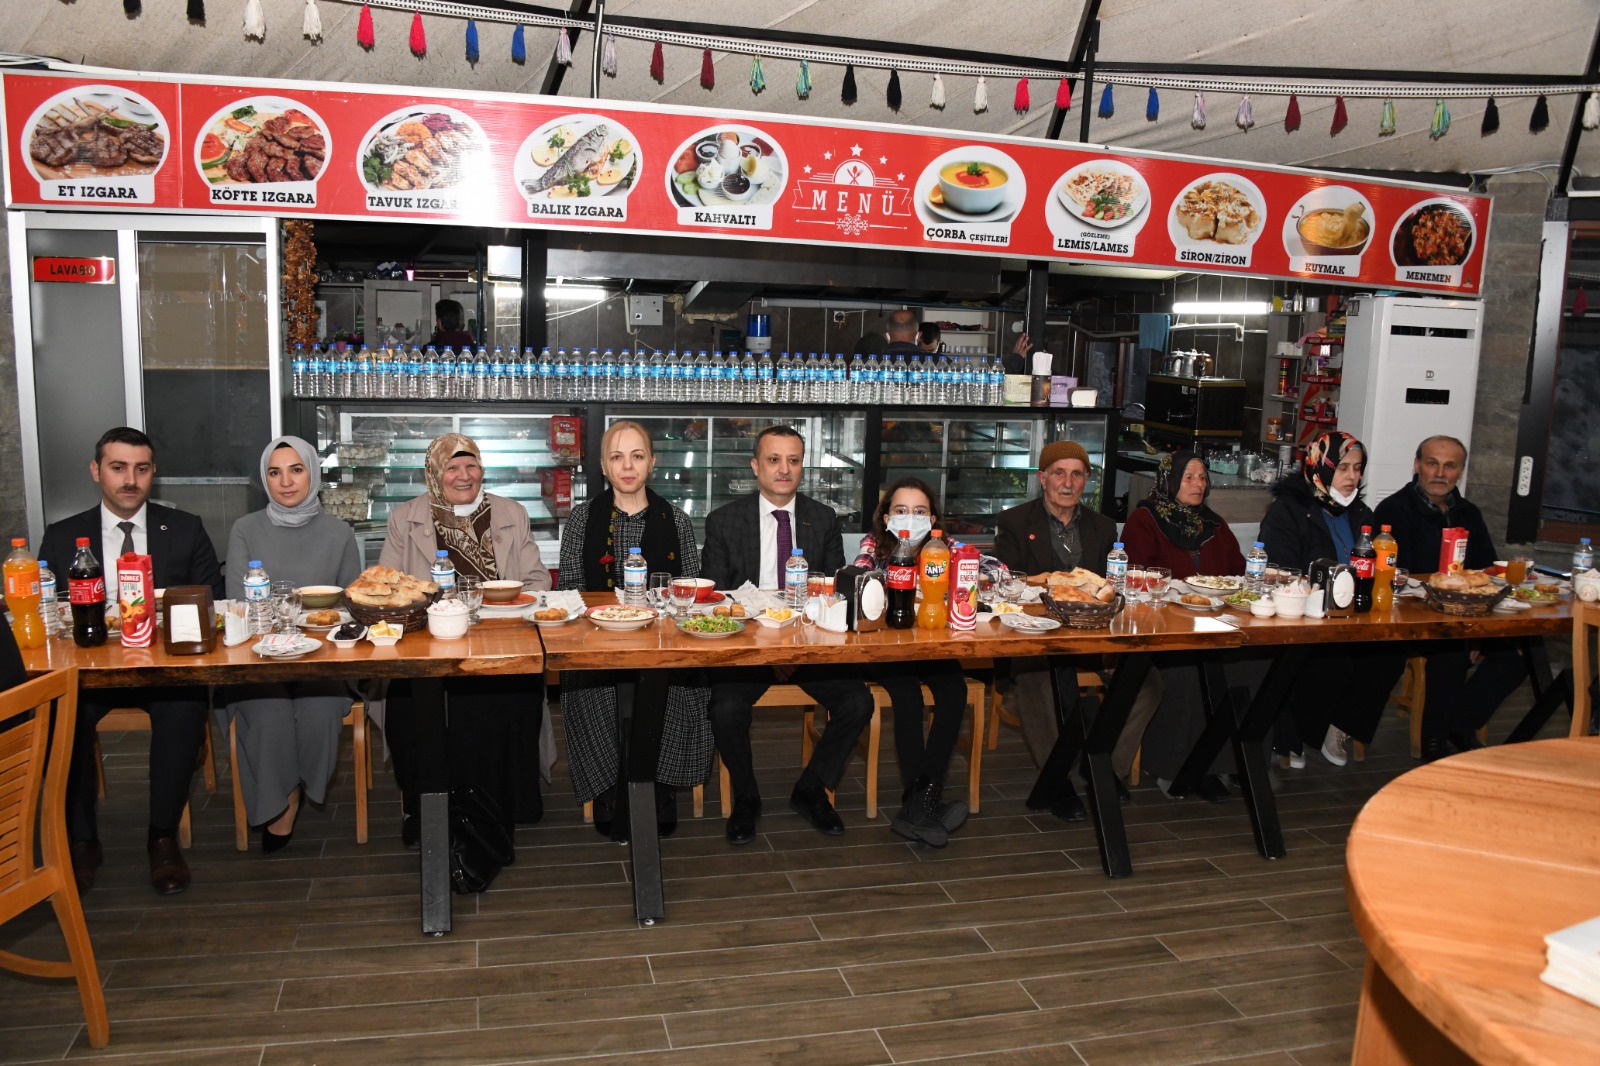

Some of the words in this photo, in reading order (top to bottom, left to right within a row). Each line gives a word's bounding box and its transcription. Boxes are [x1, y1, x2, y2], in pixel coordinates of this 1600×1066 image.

[58, 186, 76, 197] ET
[81, 187, 138, 199] IZGARA
[212, 187, 257, 201] KÖFTE
[262, 191, 315, 204] IZGARA
[368, 196, 413, 208] TAVUK
[812, 189, 895, 216] MENÜ
[532, 203, 571, 216] BALIK
[574, 205, 624, 218] IZGARA
[694, 212, 757, 226] KAHVALTI
[926, 227, 967, 240] ÇORBA
[1180, 249, 1247, 265] SİRON/ZİRON
[50, 264, 96, 277] LAVABO
[1305, 262, 1346, 275] KUYMAK
[1406, 271, 1452, 283] MENEMEN
